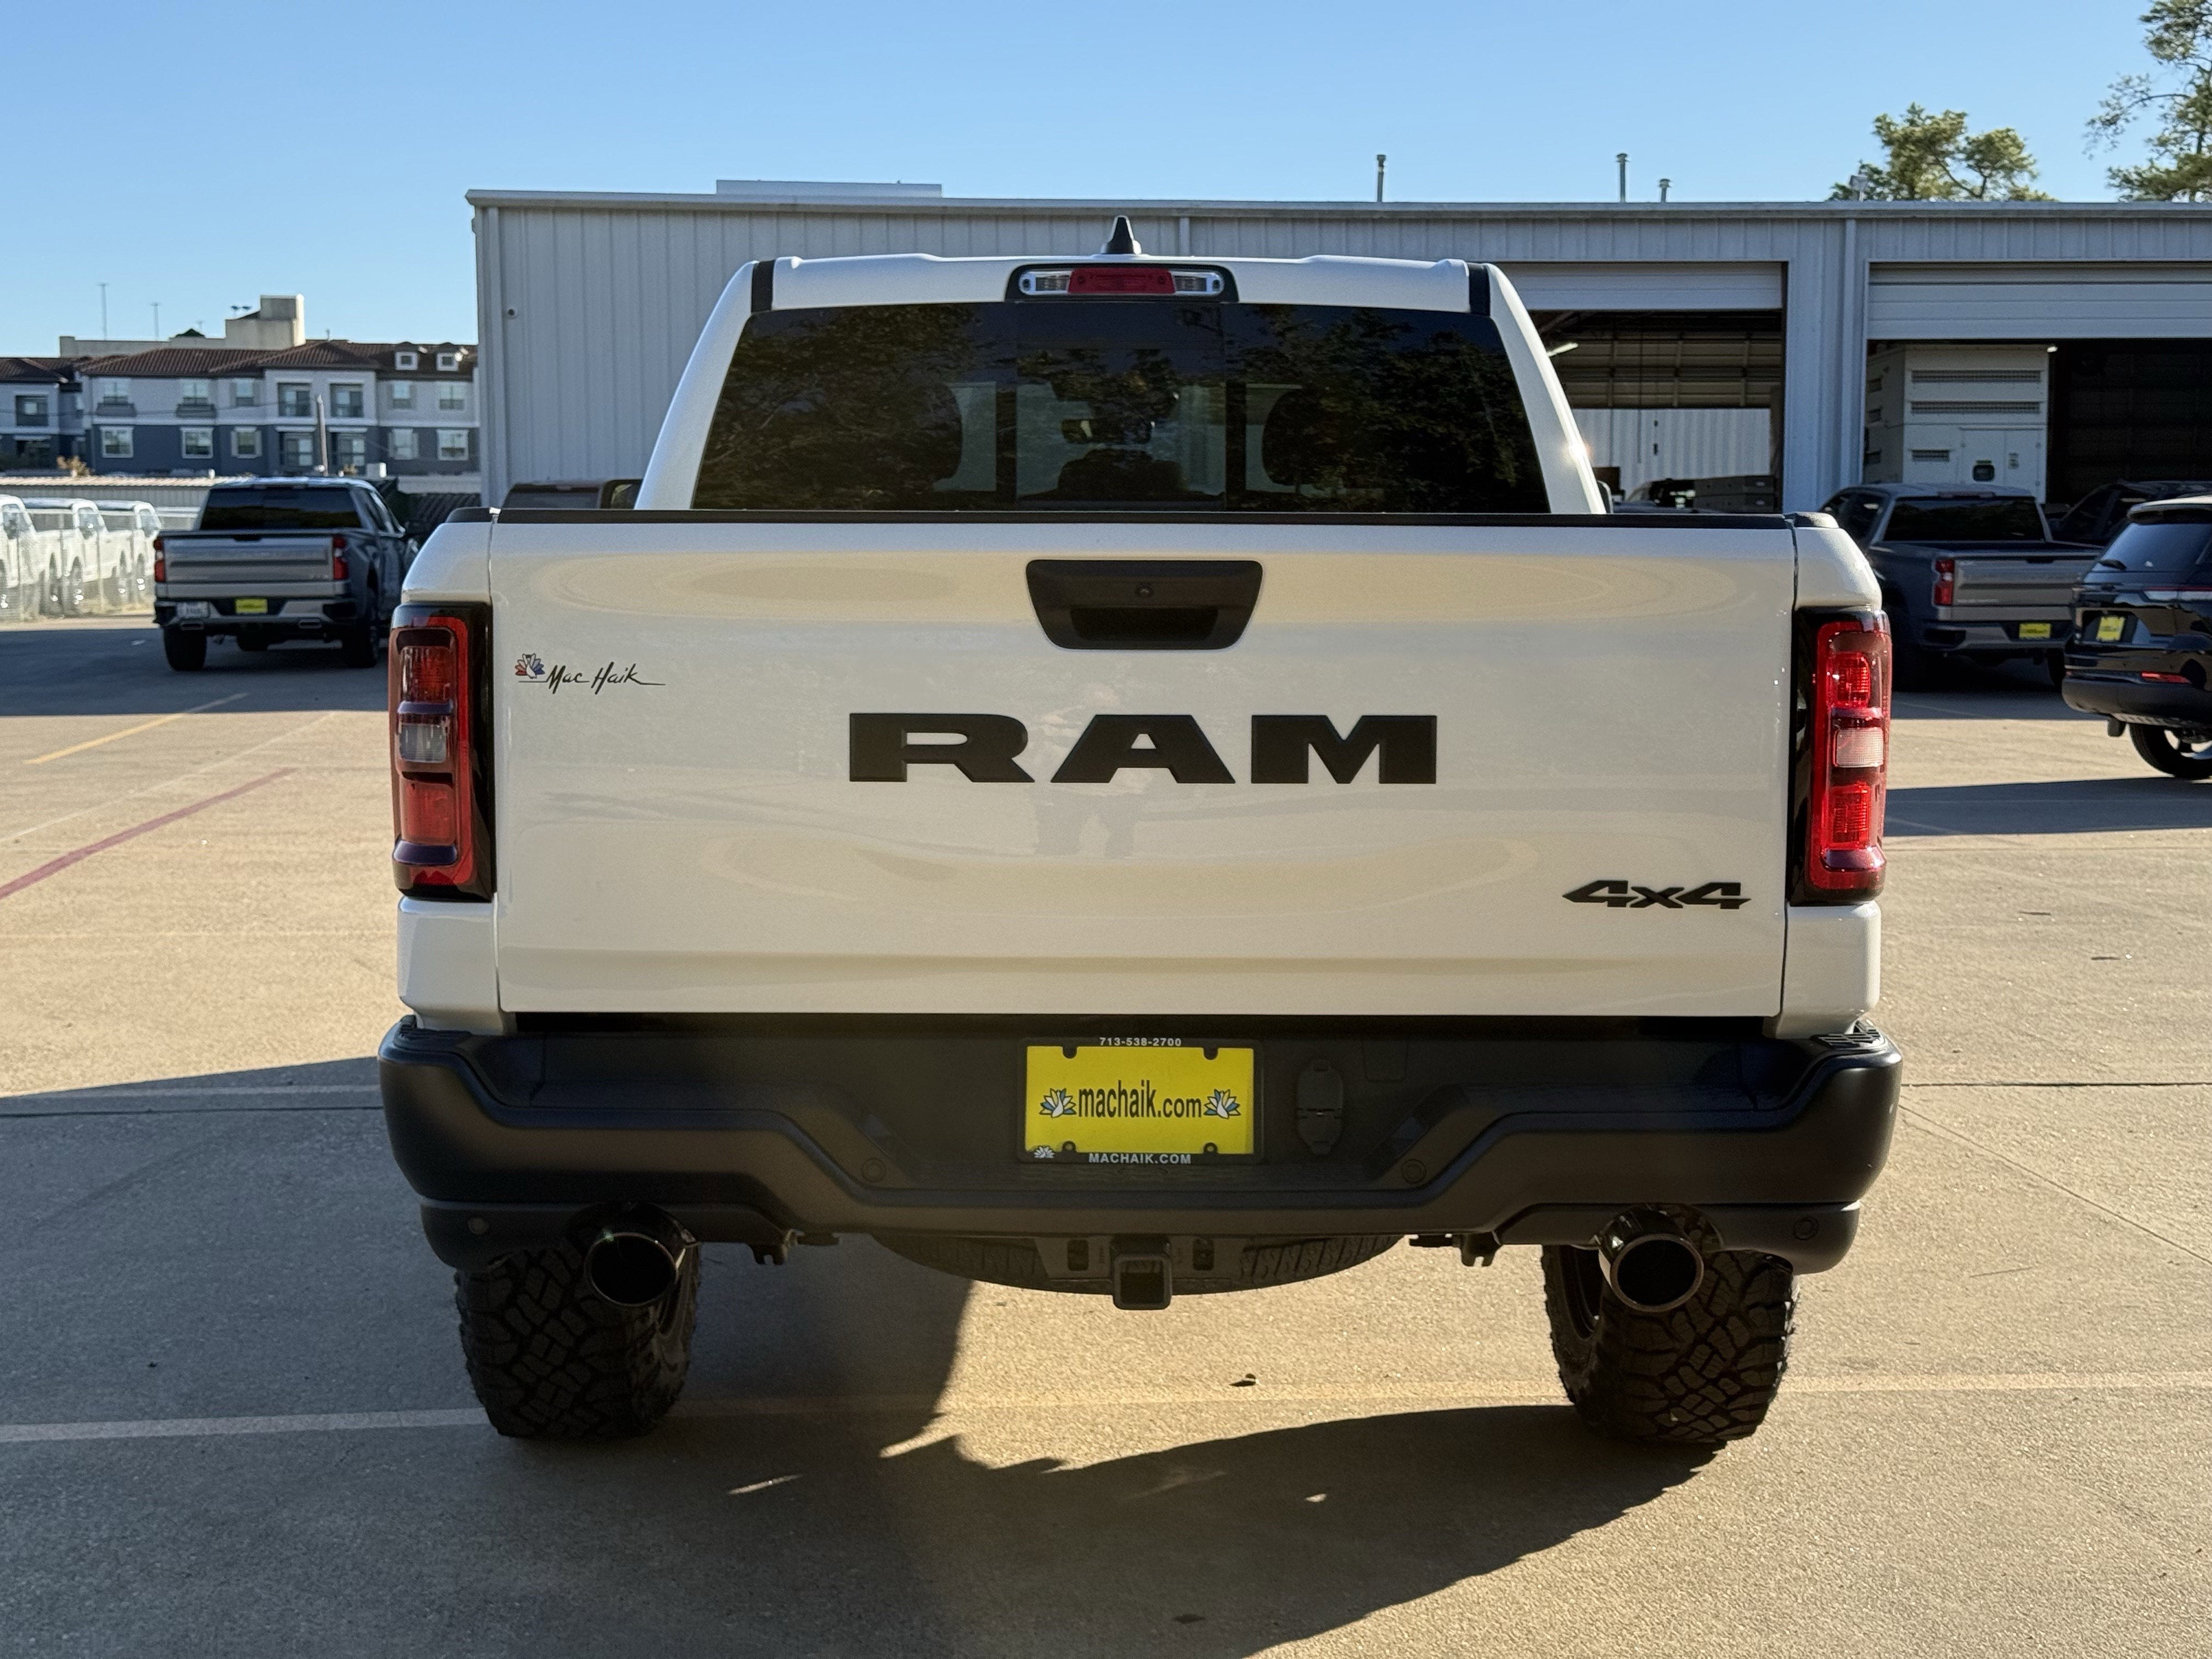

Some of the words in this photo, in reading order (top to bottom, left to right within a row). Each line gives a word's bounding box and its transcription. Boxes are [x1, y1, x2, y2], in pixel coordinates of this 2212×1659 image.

[532, 665, 590, 695] Mac
[591, 661, 664, 695] Haik
[849, 713, 1437, 784] RAM
[1561, 879, 1752, 910] 4x4
[1099, 1037, 1182, 1046] 713-538-2700
[1079, 1080, 1201, 1118] machaik.com
[1089, 1153, 1192, 1164] MACHAIK.COM
